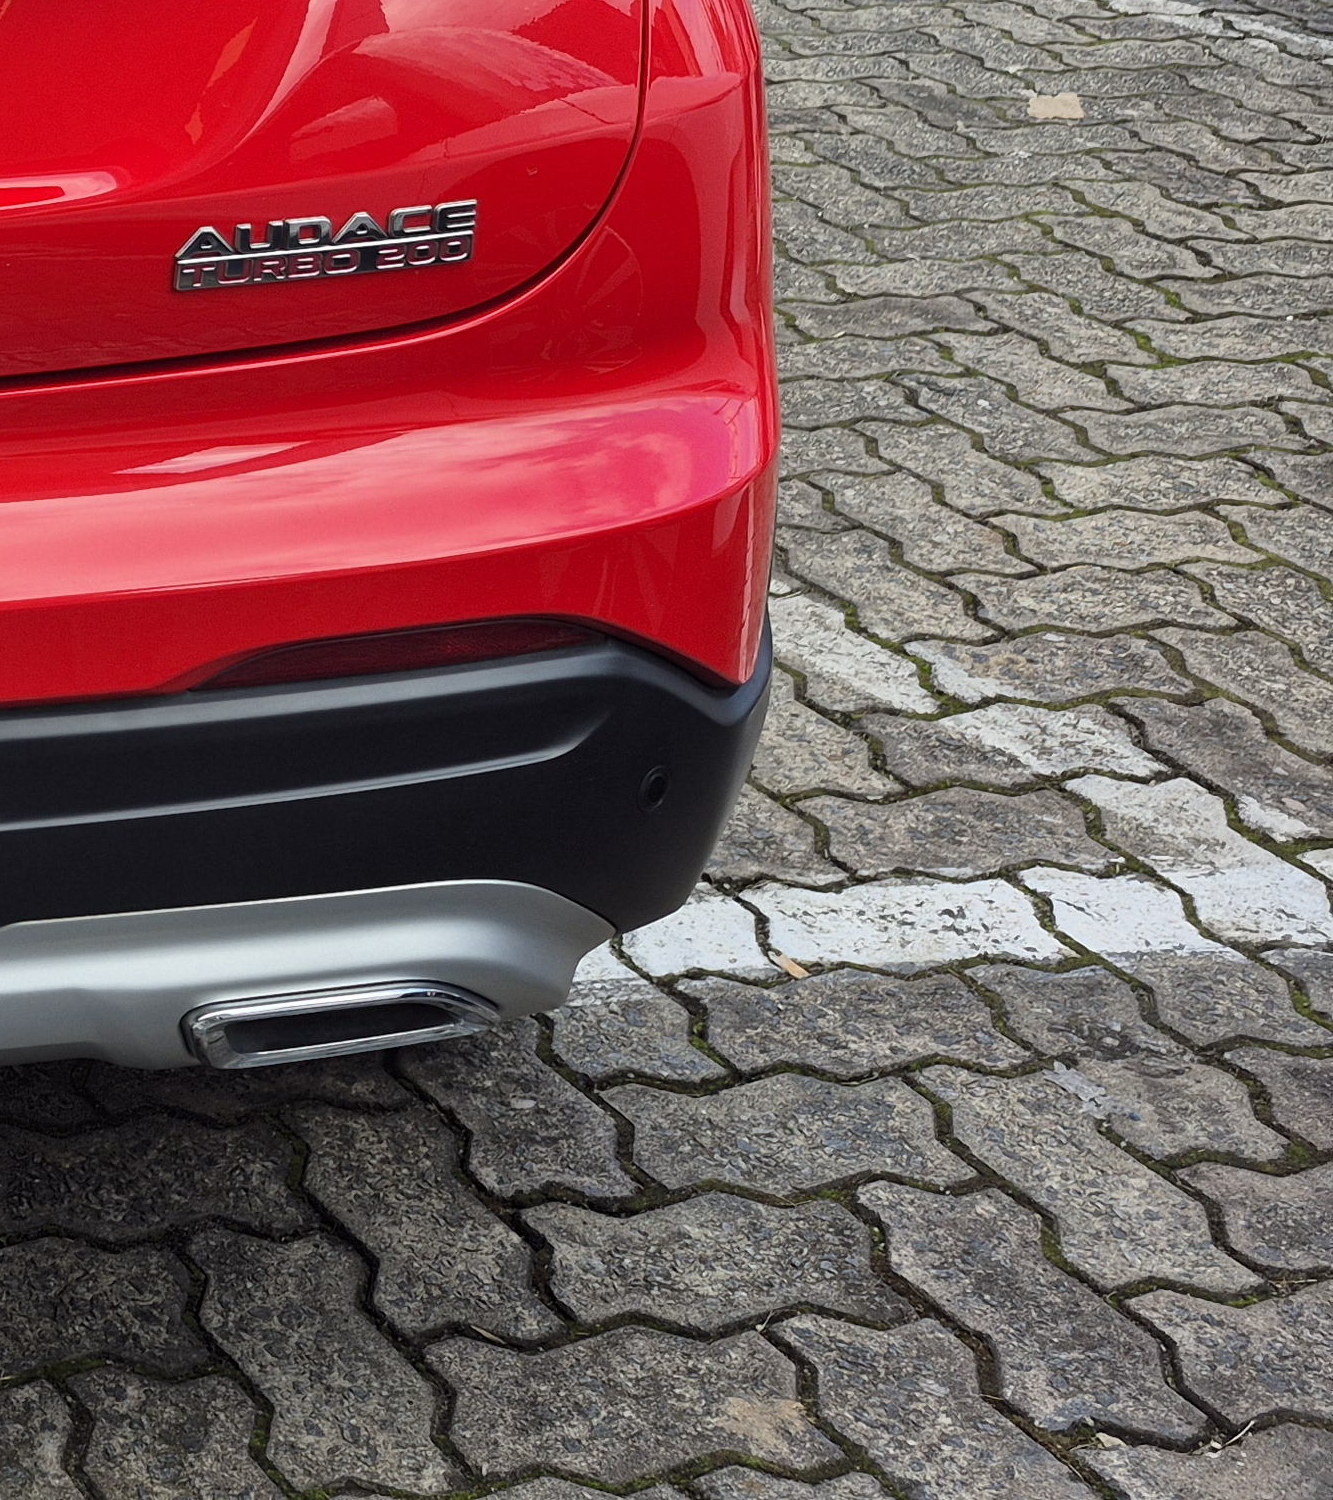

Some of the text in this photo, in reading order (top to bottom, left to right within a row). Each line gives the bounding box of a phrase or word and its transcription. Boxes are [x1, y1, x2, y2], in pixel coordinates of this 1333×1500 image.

[175, 199, 478, 259] AUDACE
[181, 236, 472, 288] TURBO 200
